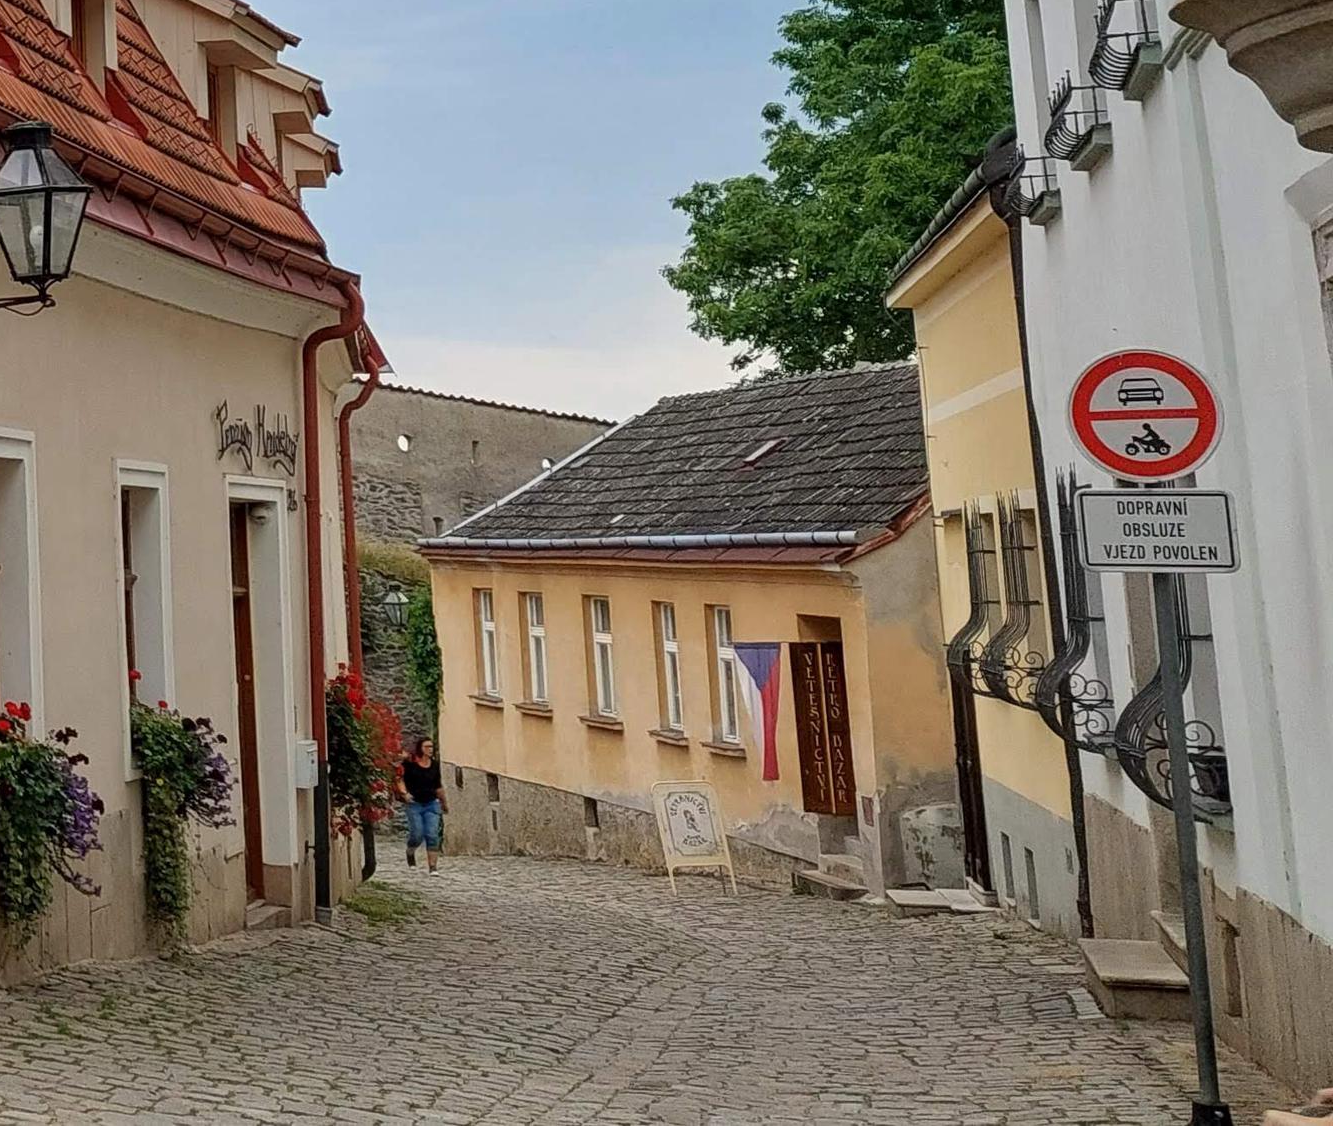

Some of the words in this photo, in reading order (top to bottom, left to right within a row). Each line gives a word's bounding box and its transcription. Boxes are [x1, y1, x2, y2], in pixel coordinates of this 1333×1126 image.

[1116, 497, 1188, 516] DOPRAVNÍ
[1122, 522, 1186, 538] OBSLUZE
[1103, 544, 1146, 560] VJEZD
[1153, 545, 1218, 561] POVOLEN
[826, 653, 841, 719] RETRO
[833, 735, 847, 804] BAZAR
